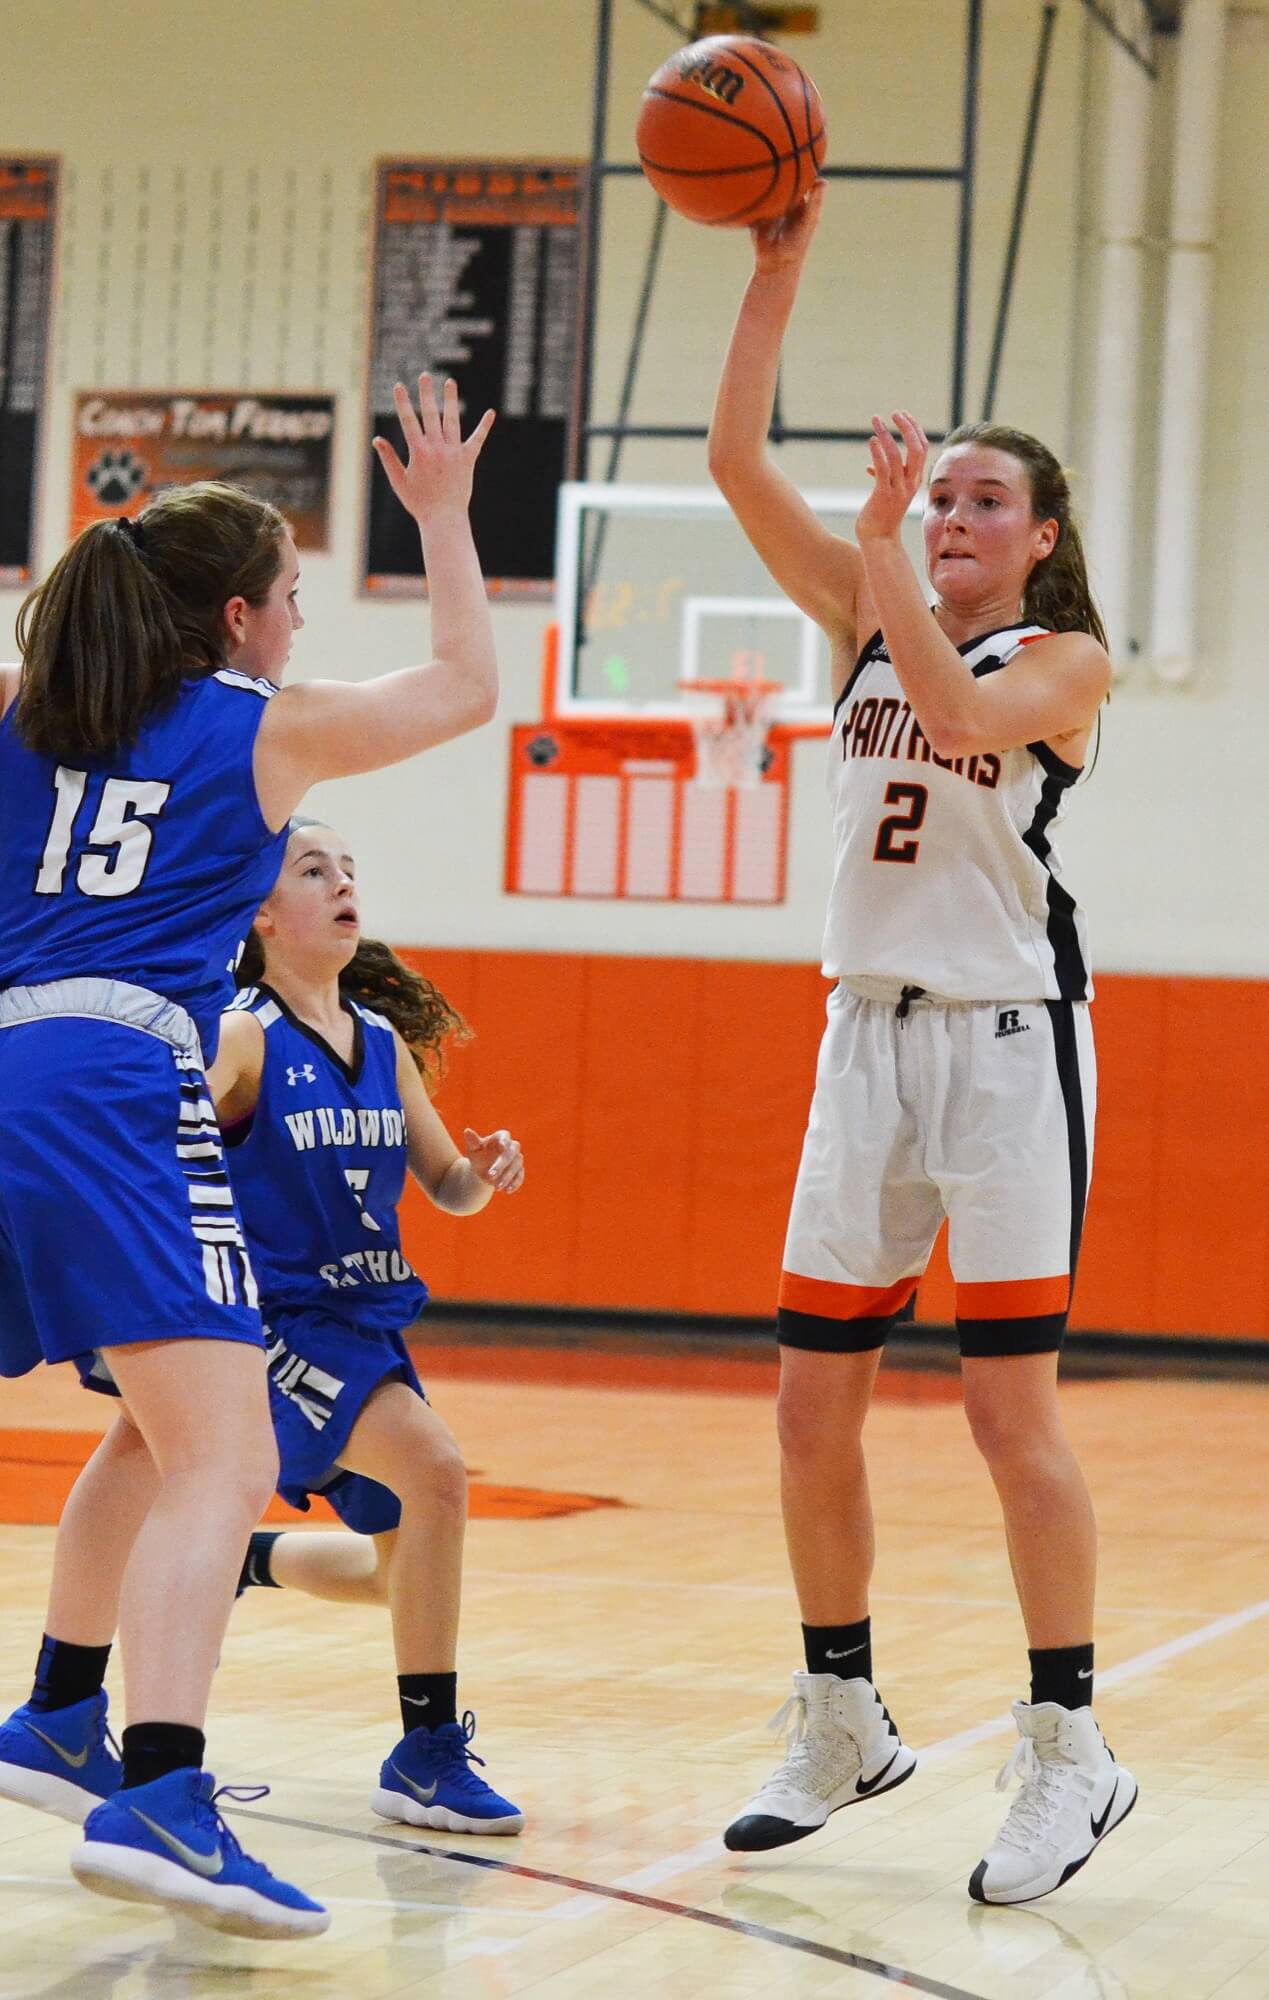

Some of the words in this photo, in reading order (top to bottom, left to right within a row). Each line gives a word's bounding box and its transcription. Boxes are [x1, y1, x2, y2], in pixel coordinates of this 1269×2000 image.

[842, 697, 1002, 789] PANTHS
[34, 764, 172, 897] 15
[872, 780, 929, 864] 2
[995, 1025, 1031, 1039] RUSSELL
[284, 1108, 408, 1151] WILDWOO
